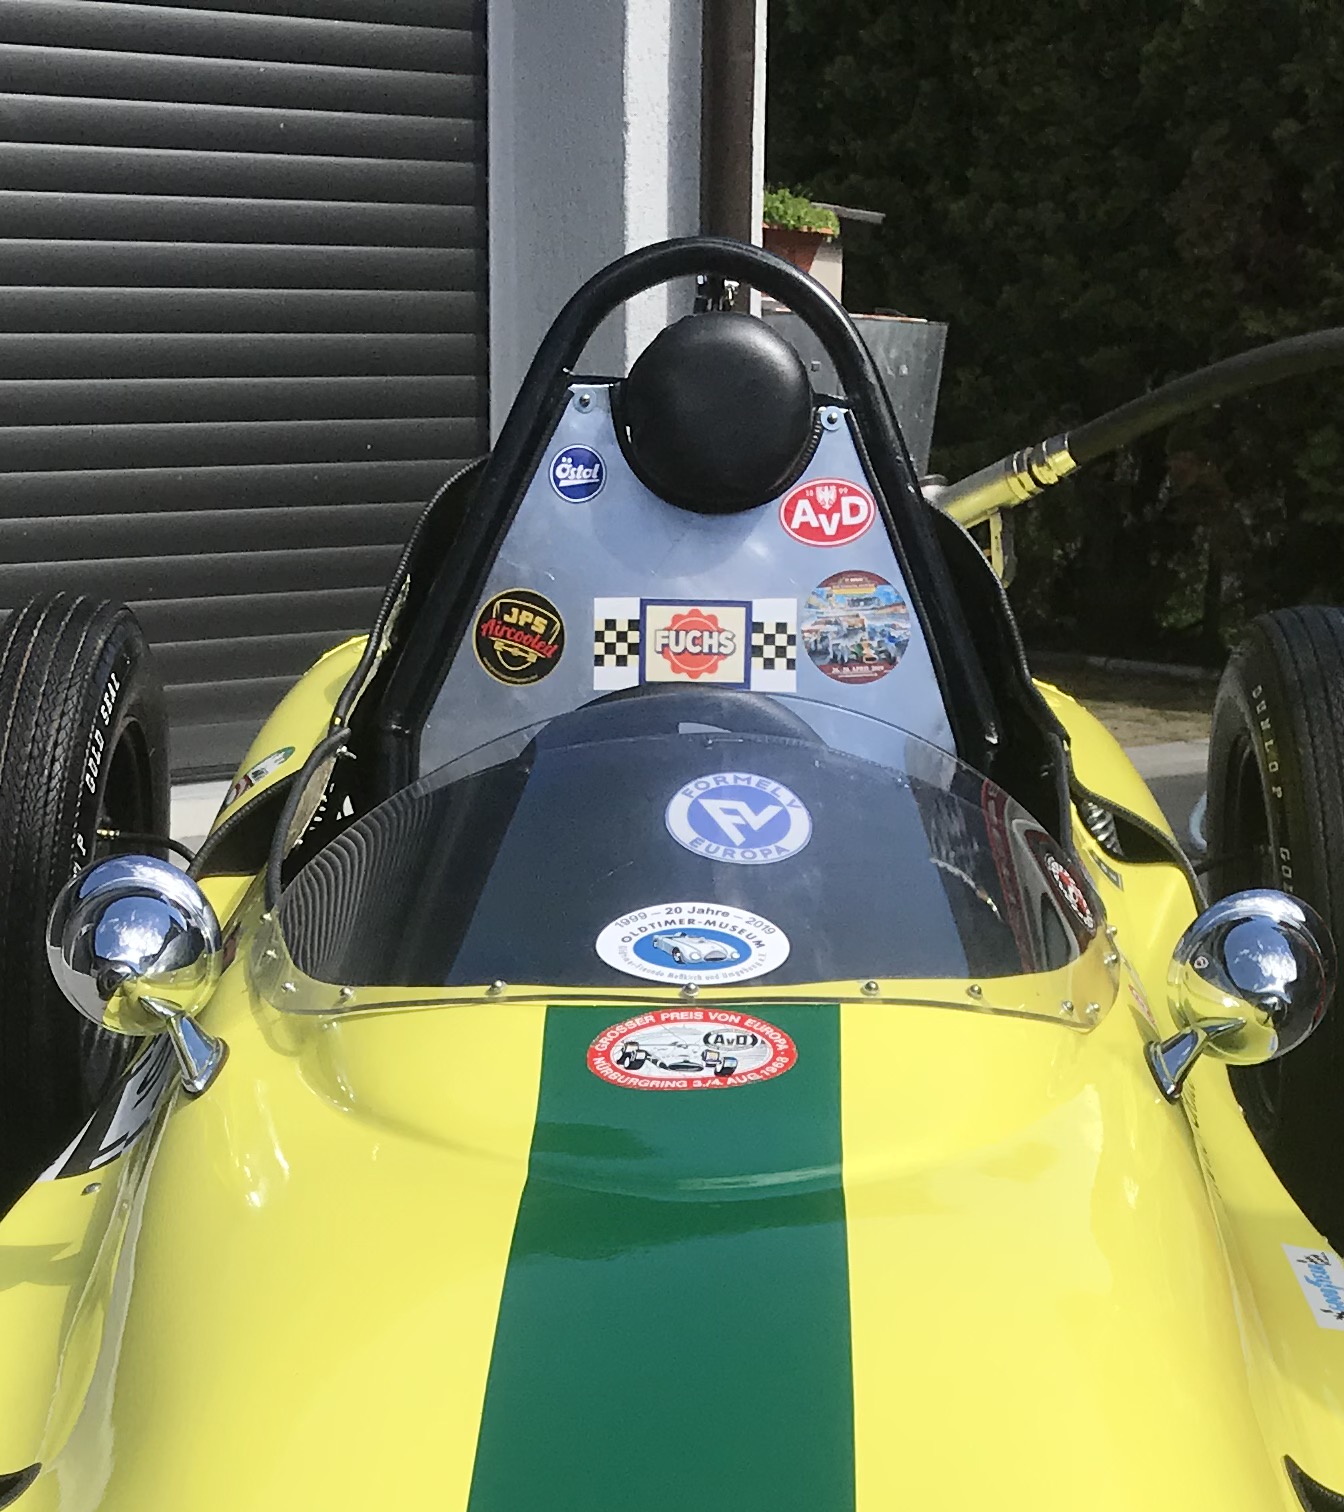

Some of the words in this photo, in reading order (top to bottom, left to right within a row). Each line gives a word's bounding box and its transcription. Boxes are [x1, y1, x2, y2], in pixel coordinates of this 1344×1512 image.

[503, 606, 548, 635] JPS
[481, 618, 558, 658] Aircooled
[654, 629, 736, 655] FUCHS
[1252, 684, 1284, 799] DUNLOP
[84, 728, 105, 794] GOLD
[681, 774, 784, 799] FORMEL
[687, 836, 791, 860] EUROPA
[615, 911, 648, 929] 1999
[664, 905, 683, 915] 20
[687, 905, 731, 918] Jahre
[744, 915, 777, 936] 2019
[620, 917, 766, 949] OLDTIMER-MUSEUM
[594, 1014, 656, 1052] GROSSER
[660, 1011, 704, 1022] PREIS
[708, 1011, 742, 1024] VON
[743, 1018, 790, 1051] EUROPA
